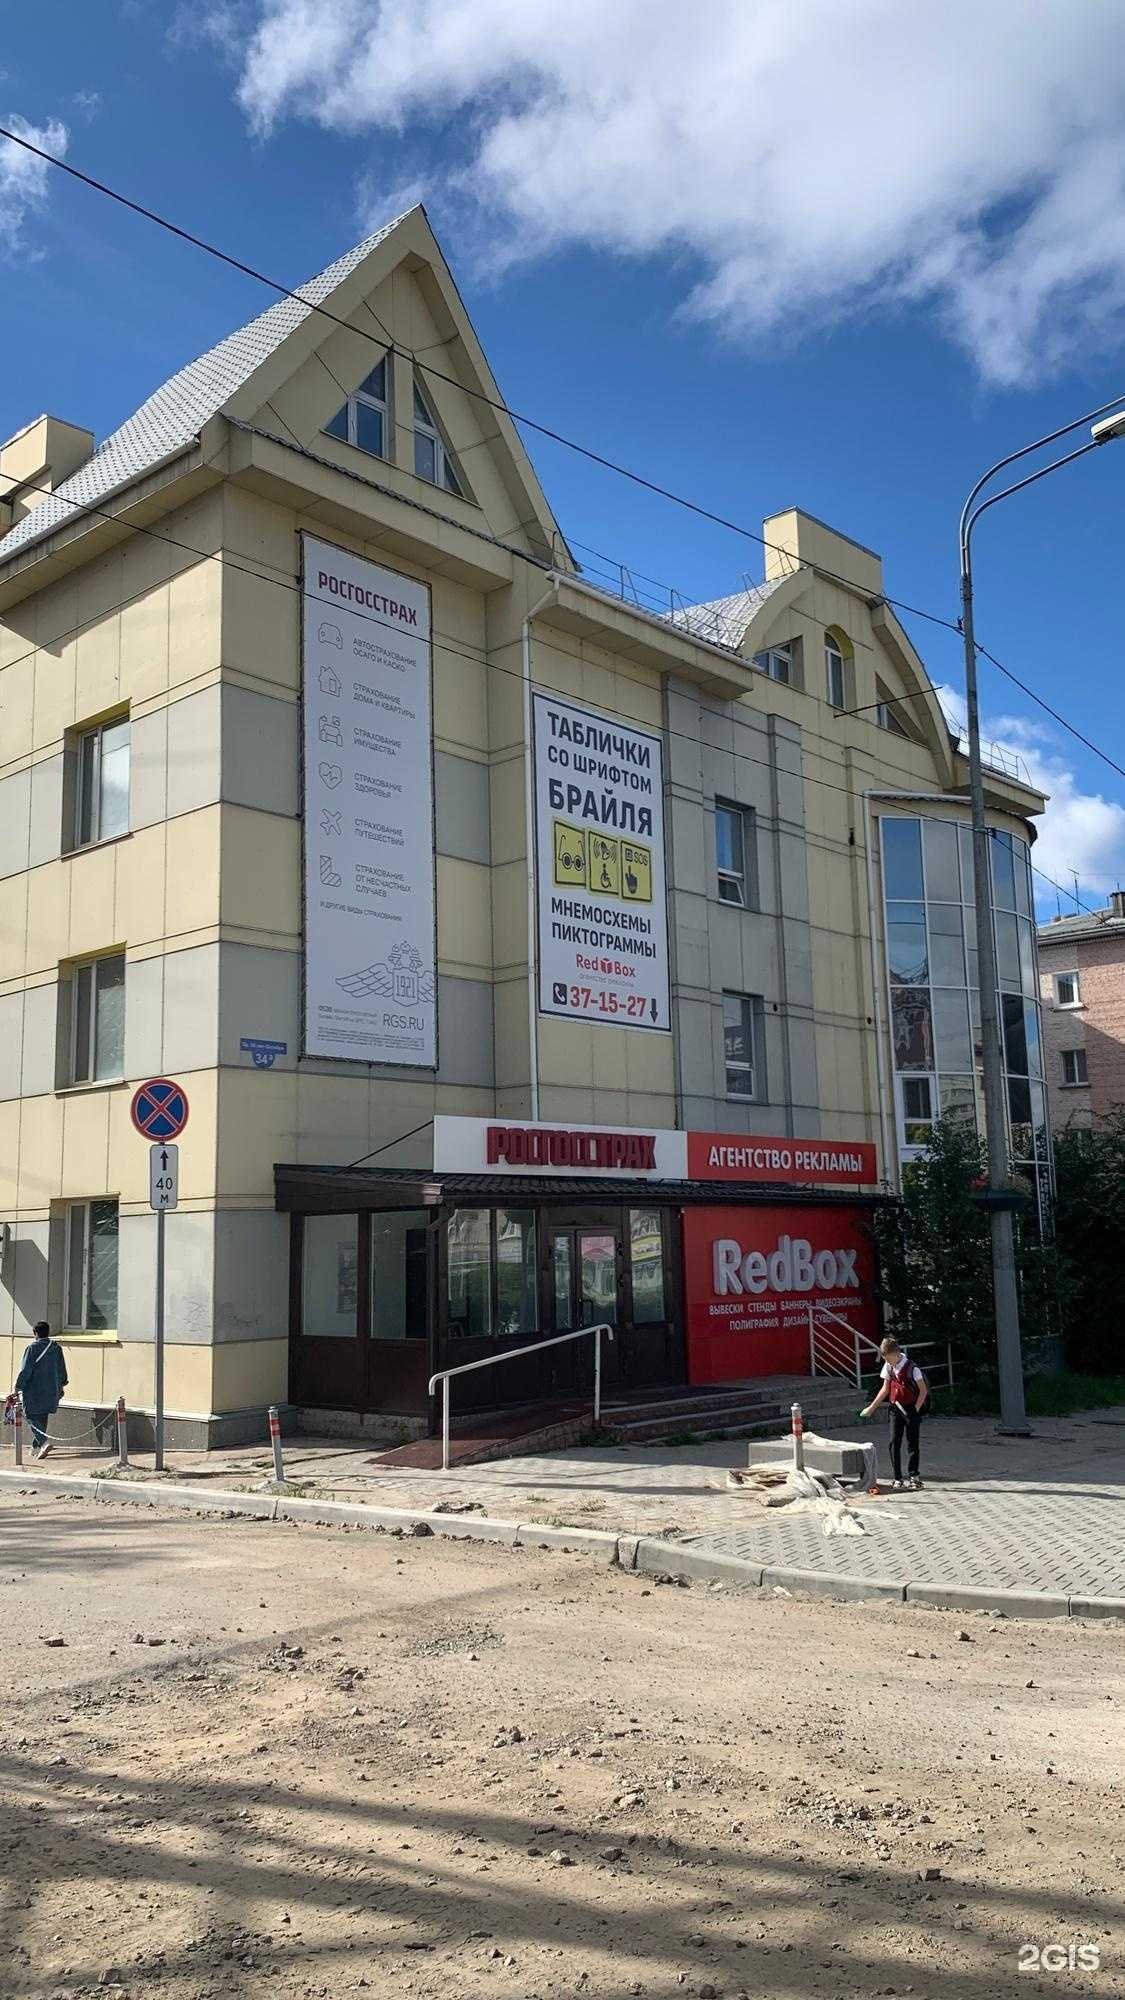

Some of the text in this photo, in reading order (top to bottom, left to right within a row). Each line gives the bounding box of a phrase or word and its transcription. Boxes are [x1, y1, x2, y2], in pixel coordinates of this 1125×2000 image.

[318, 571, 417, 626] РОСГОССТРАХ
[353, 638, 417, 667] АВТОСТРАХОВАНИЕ
[353, 682, 401, 704] СТРАХОВАНИЕ
[353, 727, 401, 749] СТРАХОВАНИЕ
[547, 711, 650, 769] ТАБЛИЧКИ
[354, 772, 402, 793] СТРАХОВАНИЕ
[548, 745, 652, 795] СО ШРИФТОМ
[549, 778, 652, 836] БРАЙЛЯ
[355, 818, 402, 837] СТРАХОВАНИЕ
[634, 851, 648, 866] SOS
[355, 864, 404, 881] СТРАХОВАНИЕ
[551, 897, 651, 934] МНЕМОСХЕМЫ
[552, 922, 656, 959] ПИКТОГРАММЫ
[576, 954, 636, 978] Red Box
[570, 986, 647, 1017] 37-15-27
[383, 1013, 424, 1031] RGS.RU
[487, 1127, 657, 1169] РОСГОССТРАХ
[709, 1146, 863, 1172] АГЕНТСТВО РЕКЛАМЫ
[156, 1177, 173, 1190] 40
[713, 1234, 859, 1296] RedBox
[709, 1303, 743, 1315] ВЫВЕСКИ
[748, 1301, 777, 1313] СТЕНДЫ
[780, 1300, 811, 1311] БАННЕРЫ
[730, 1317, 779, 1330] ПОЛИГРАФИЯ
[783, 1313, 810, 1328] ДИЗАЙН
